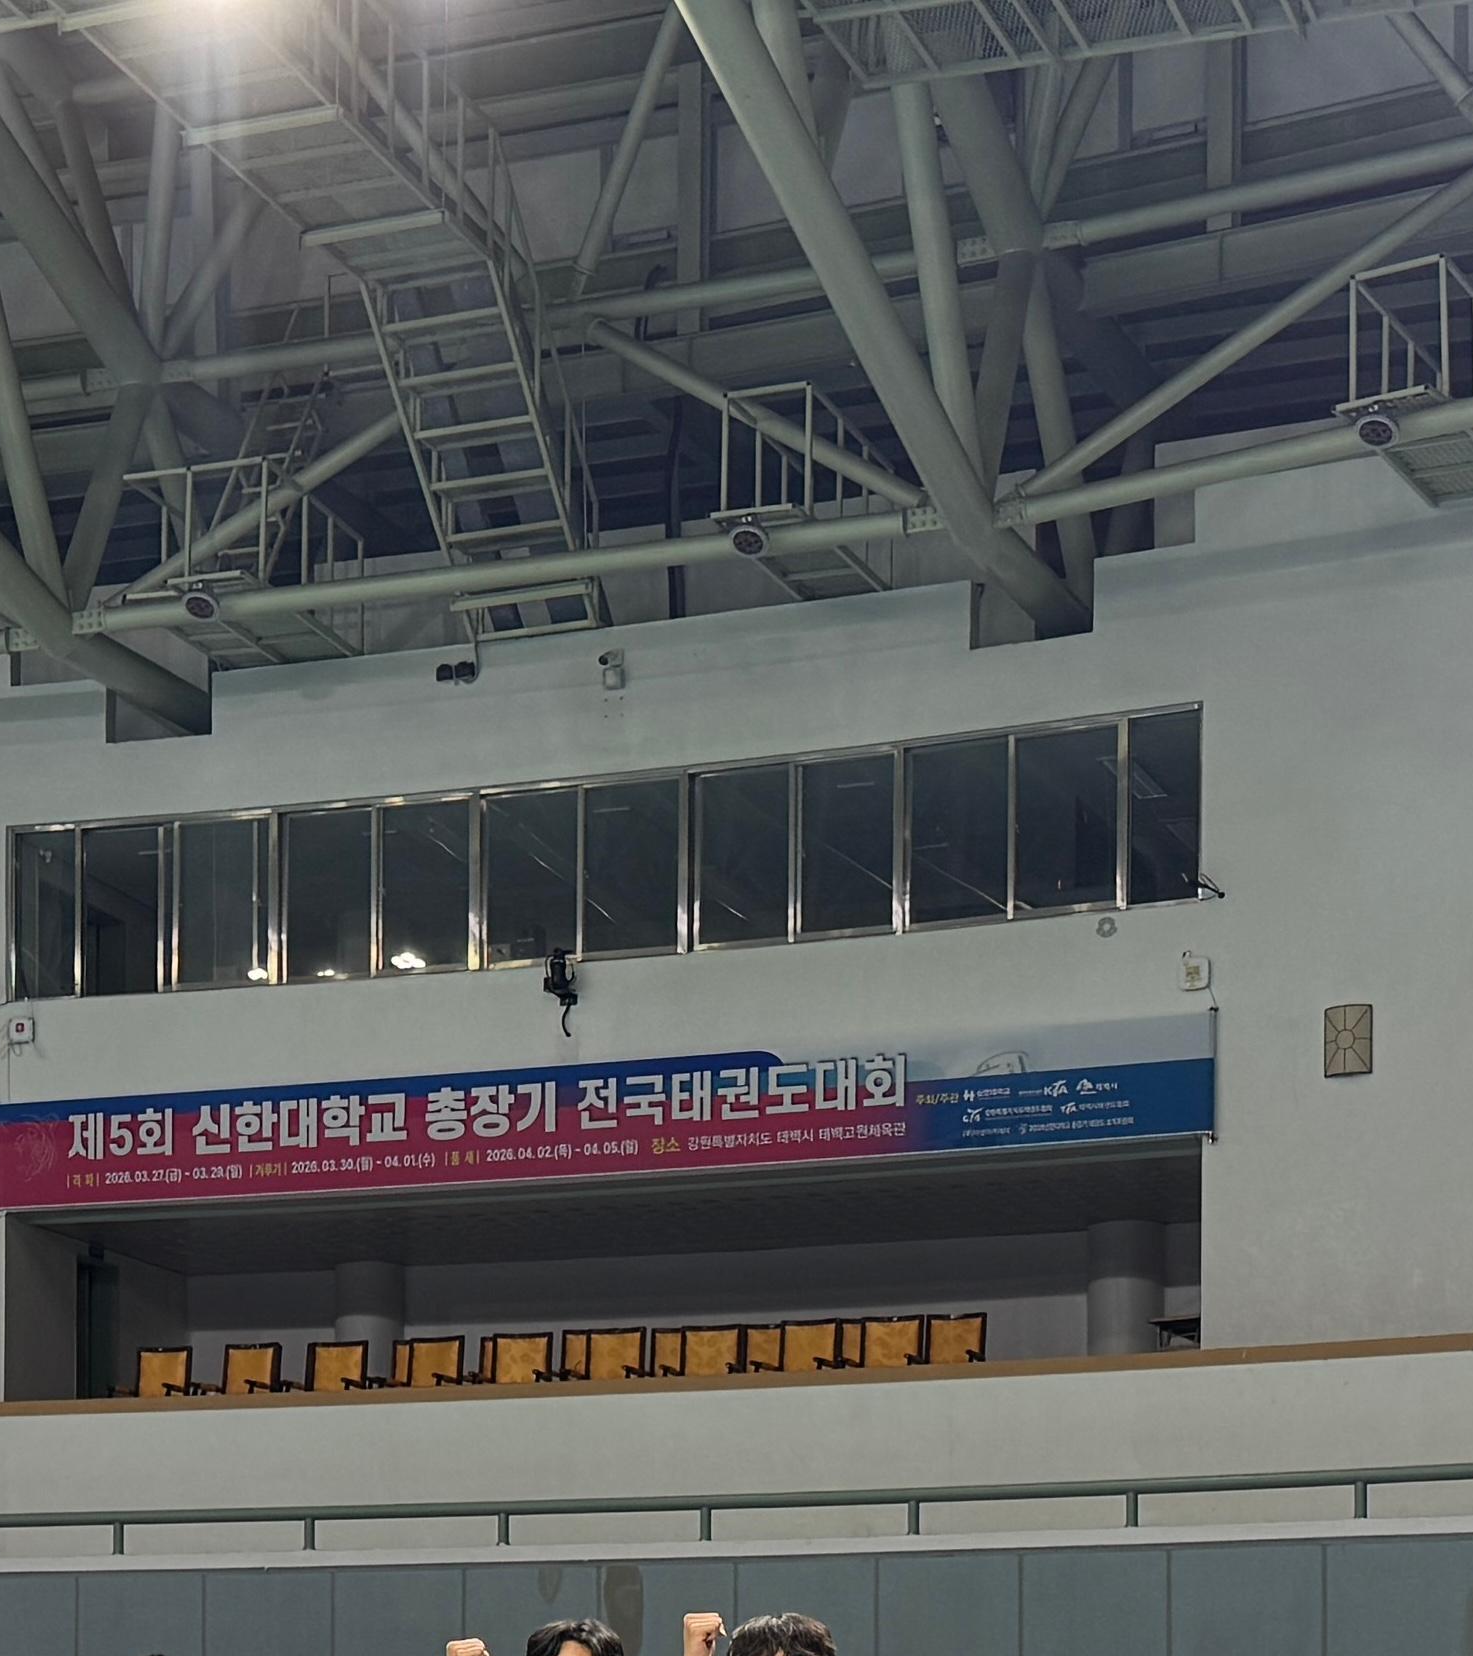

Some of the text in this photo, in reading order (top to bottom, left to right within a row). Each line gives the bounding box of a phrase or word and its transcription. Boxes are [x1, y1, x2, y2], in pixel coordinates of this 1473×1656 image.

[67, 1053, 907, 1160] 제5회 신한대학교 총장기 전국태권도대회
[651, 1136, 681, 1154] 장소
